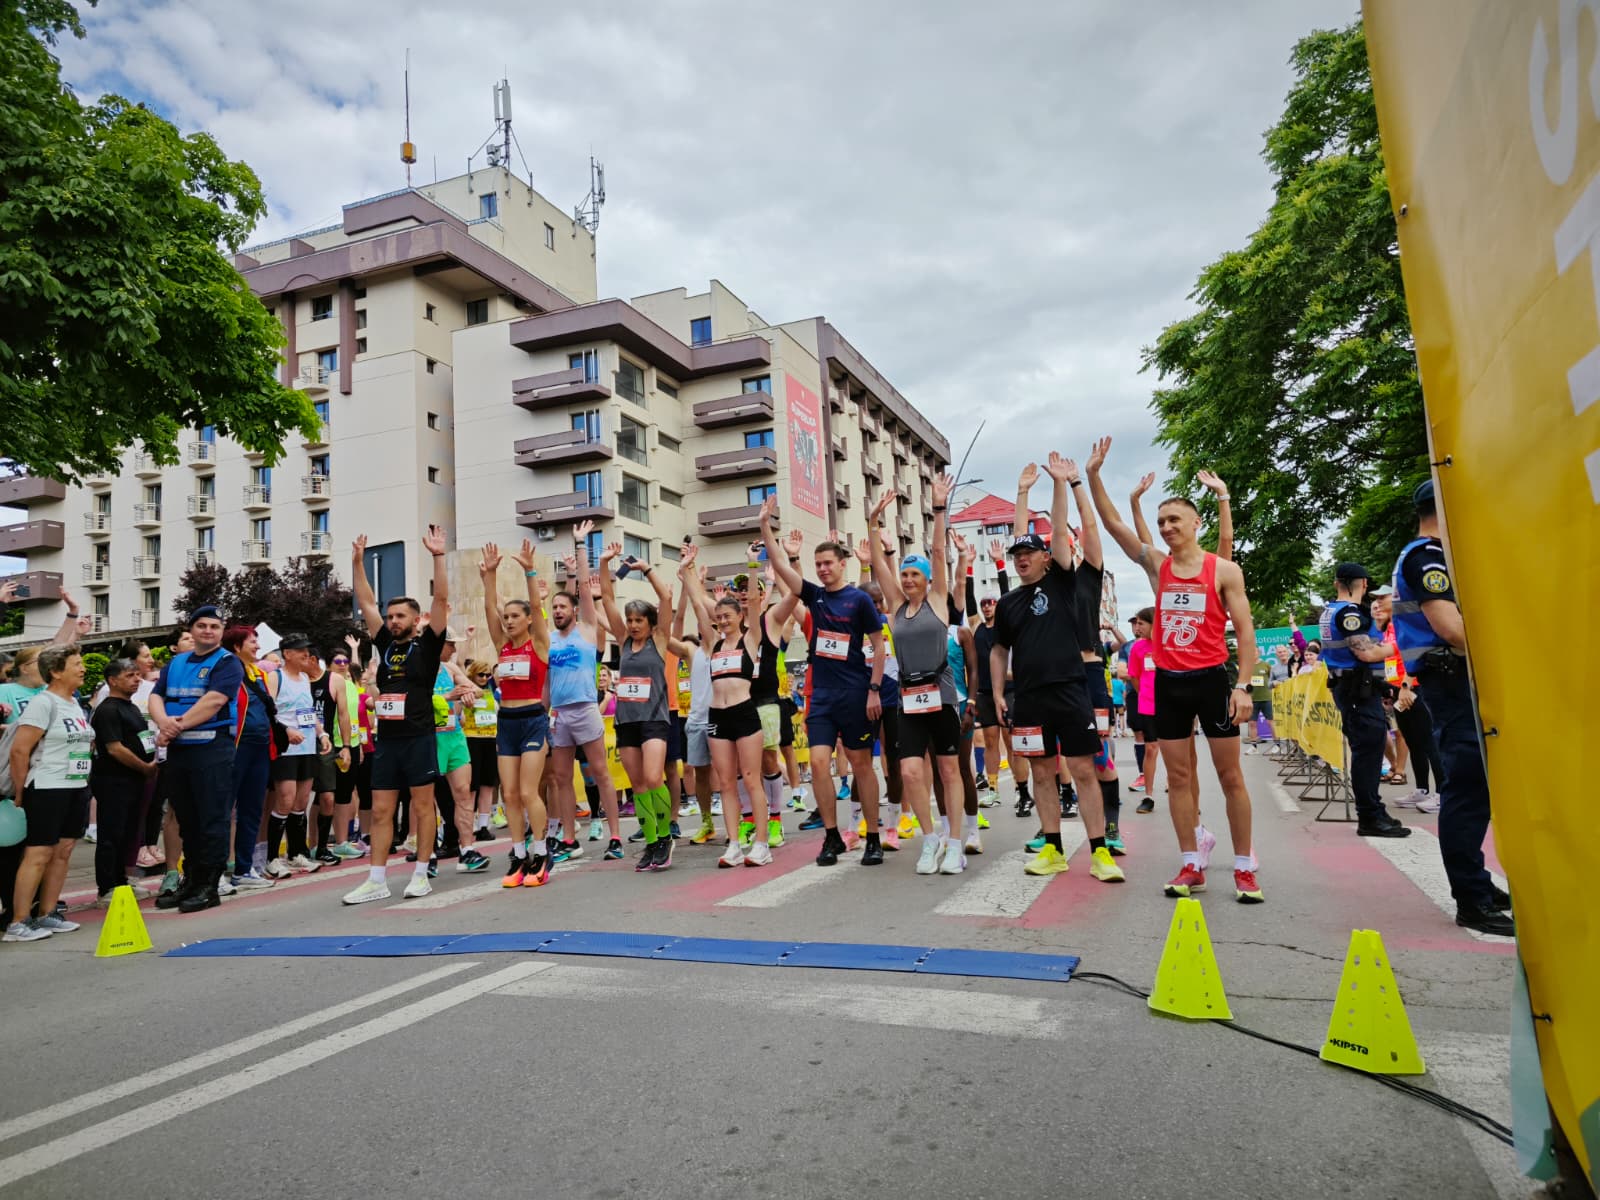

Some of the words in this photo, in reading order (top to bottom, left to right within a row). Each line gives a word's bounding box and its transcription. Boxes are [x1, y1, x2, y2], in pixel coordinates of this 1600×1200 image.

[1174, 593, 1190, 605] 25
[824, 639, 837, 649] 24
[722, 657, 728, 665] 2
[509, 663, 515, 671] 1
[627, 684, 639, 693] 13
[915, 693, 929, 703] 42
[382, 701, 394, 710] 45
[1022, 736, 1028, 746] 4
[76, 760, 88, 770] 611
